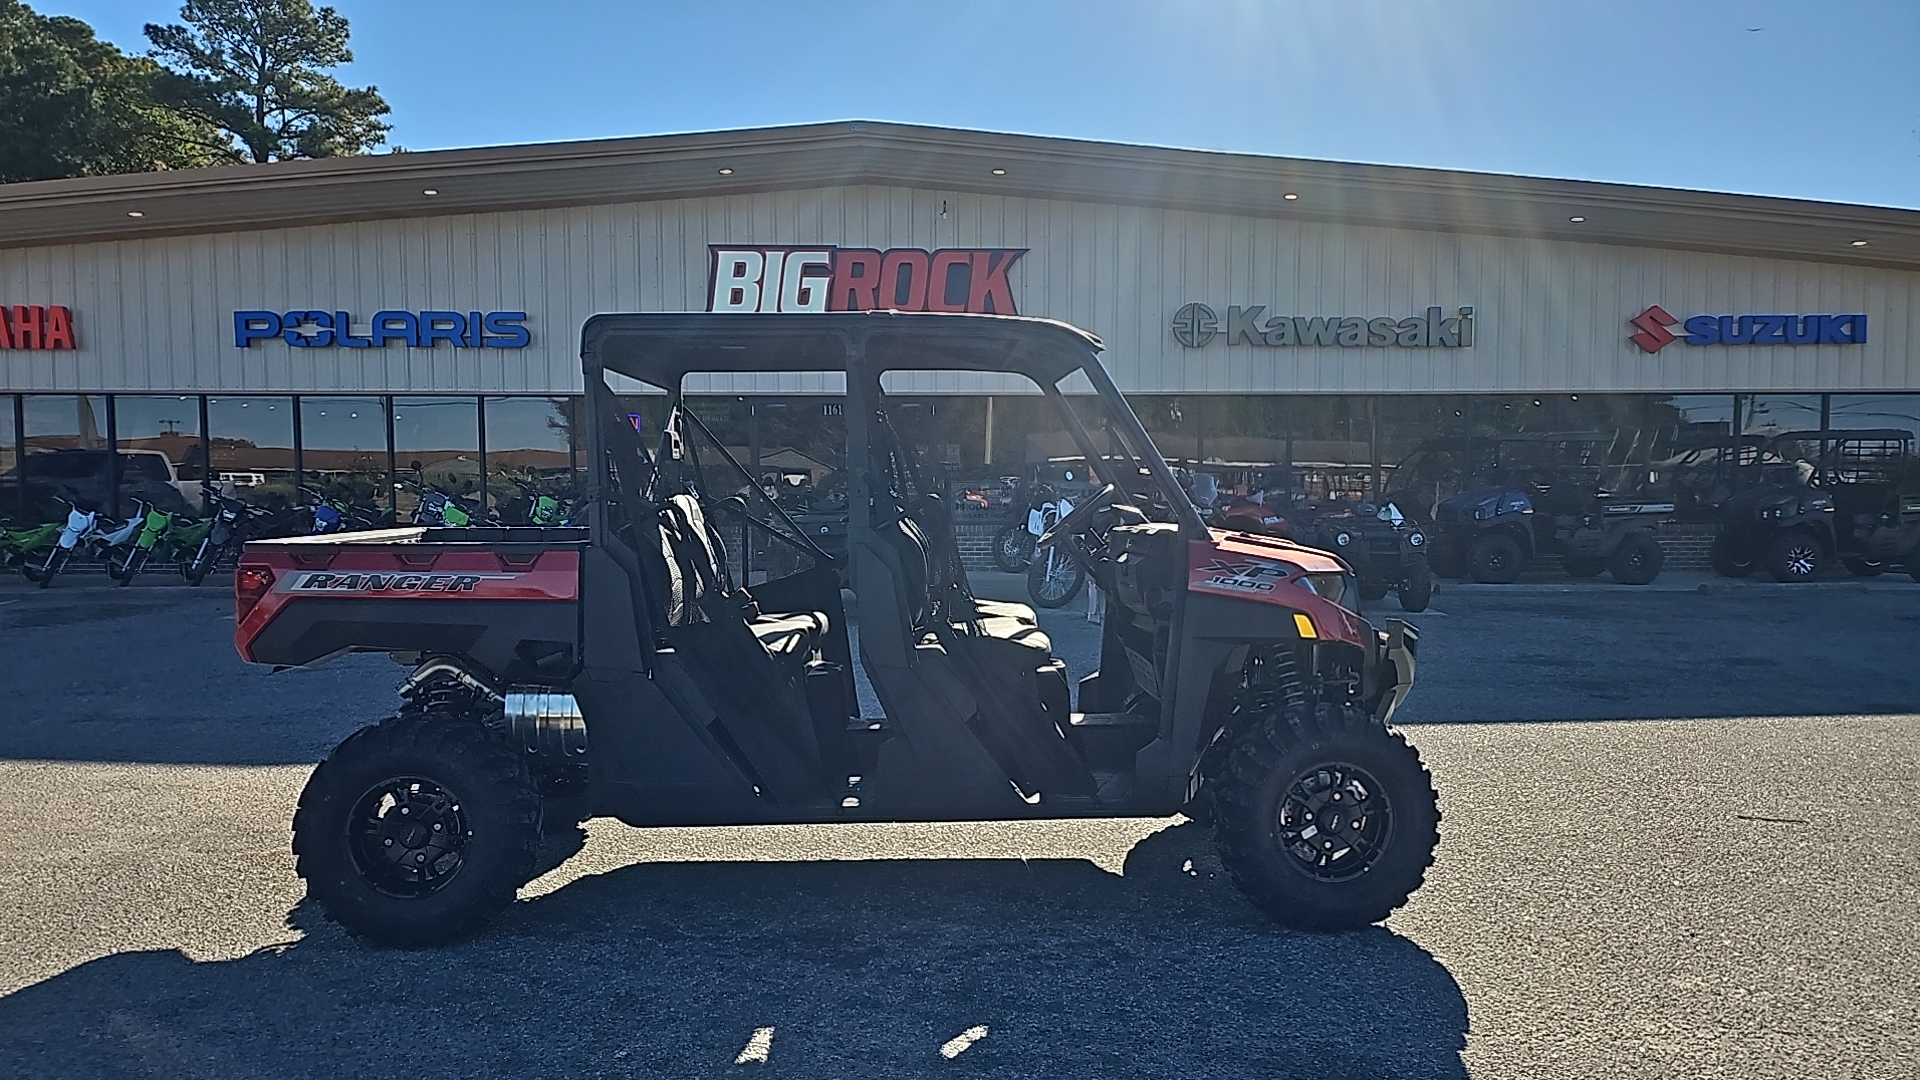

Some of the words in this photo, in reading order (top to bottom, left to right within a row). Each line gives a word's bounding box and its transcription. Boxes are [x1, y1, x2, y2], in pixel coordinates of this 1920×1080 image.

[233, 309, 531, 348] POLARIS
[1227, 304, 1474, 348] Kawasaki
[1683, 313, 1868, 346] SUZUKI
[822, 404, 844, 416] 1161
[1194, 558, 1290, 579] XP
[299, 572, 485, 593] RANGER
[1204, 575, 1277, 592] 1000
